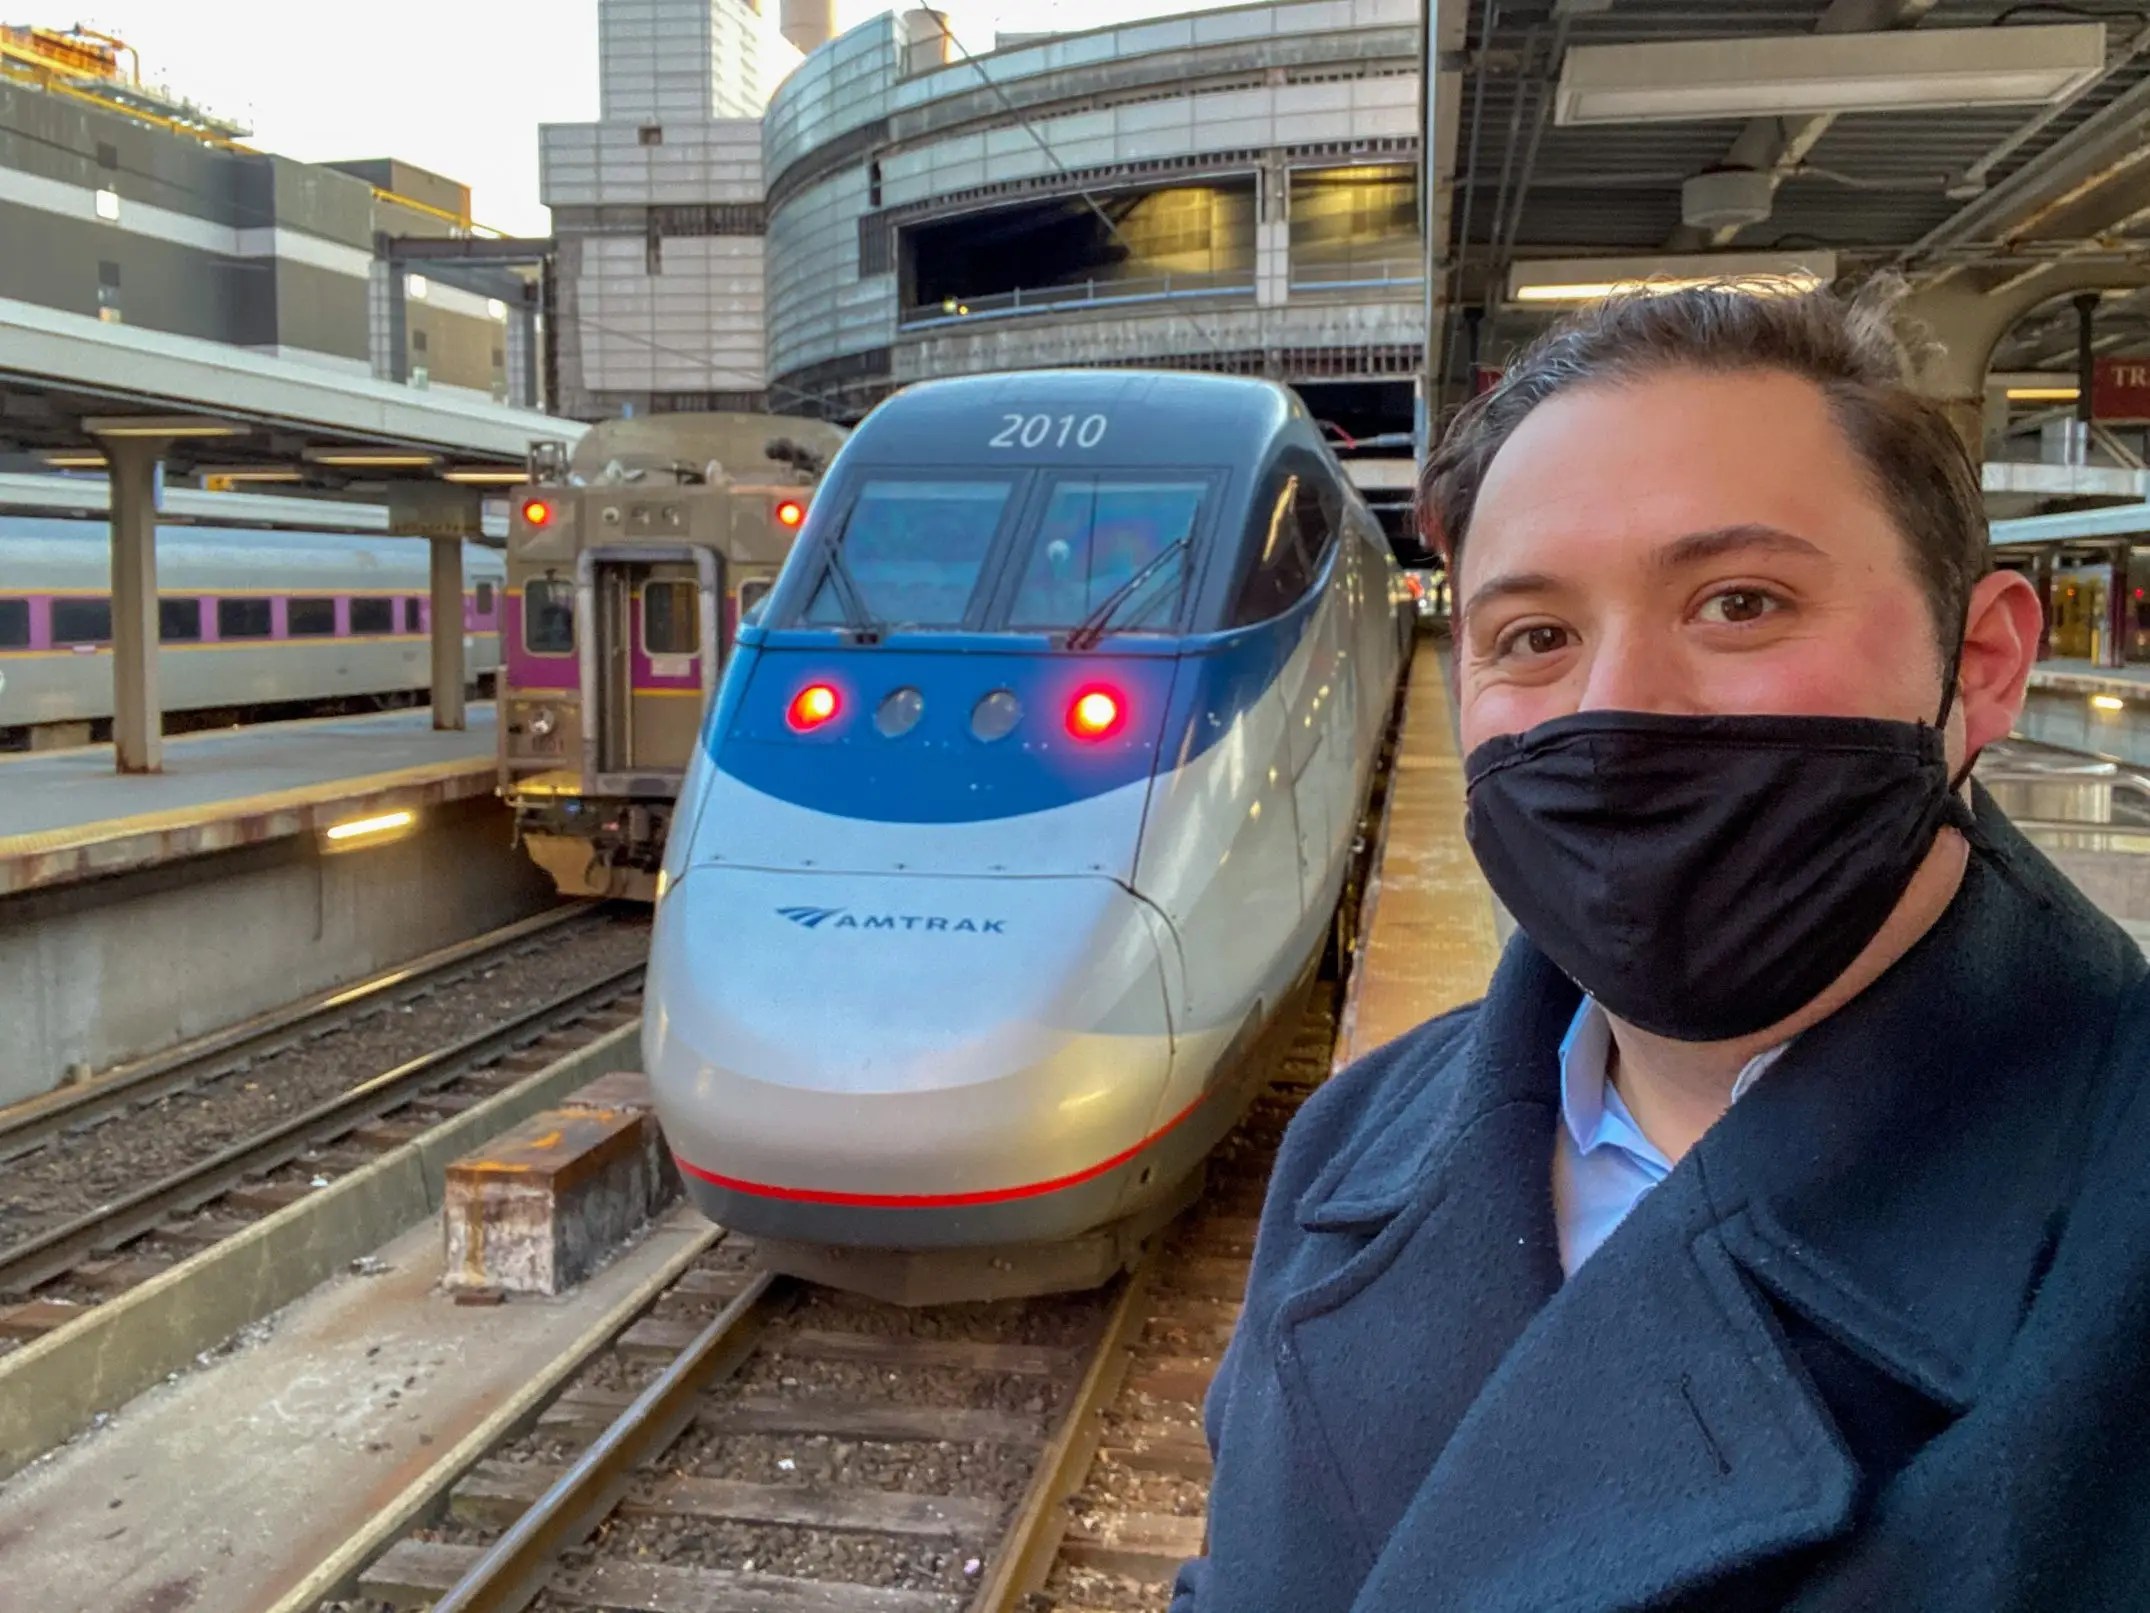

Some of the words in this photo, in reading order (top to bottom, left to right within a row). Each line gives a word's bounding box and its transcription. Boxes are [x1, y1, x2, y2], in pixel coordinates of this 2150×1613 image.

[2110, 366, 2150, 388] TR
[988, 413, 1107, 448] 2010
[834, 914, 1008, 934] AMTRAK
